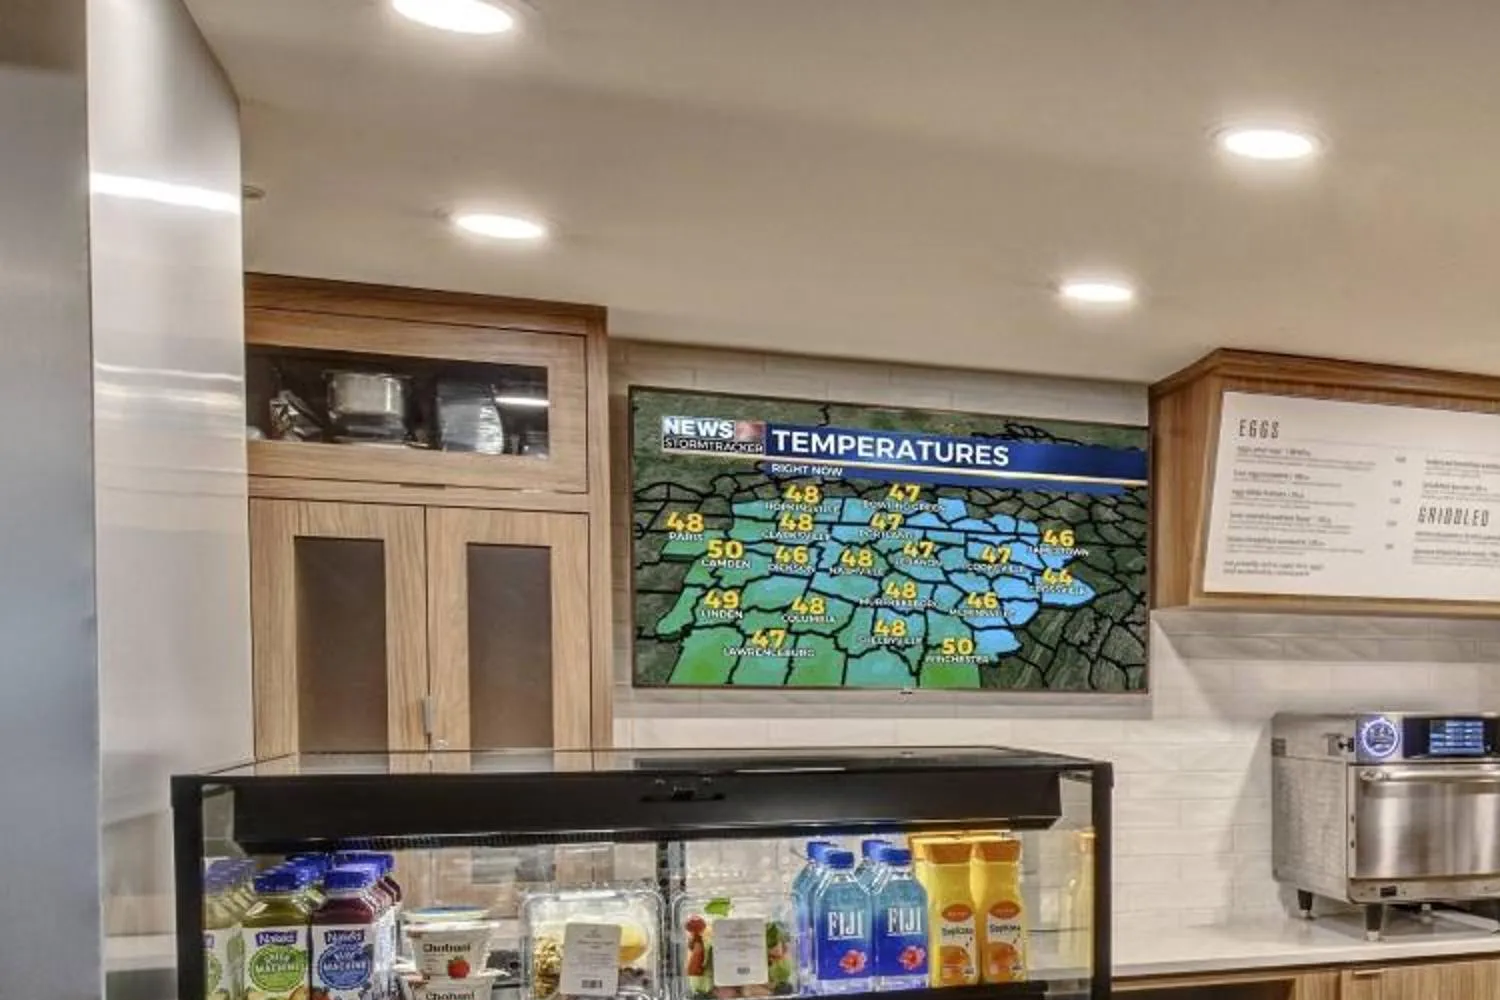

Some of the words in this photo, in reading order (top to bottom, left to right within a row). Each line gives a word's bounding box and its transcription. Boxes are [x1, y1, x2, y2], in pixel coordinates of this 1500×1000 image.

[663, 418, 734, 439] NEWS
[1238, 418, 1280, 440] EGGS
[664, 438, 763, 454] STORMTRACKER
[772, 429, 1009, 466] TEMPERATURES
[772, 463, 809, 475] RIGHT
[812, 466, 844, 477] NOW
[784, 484, 820, 504] 48
[888, 483, 921, 502] 47
[666, 512, 705, 533] 48
[779, 512, 814, 533] 48
[870, 512, 904, 531] 47
[1416, 506, 1490, 527] GRIDDLED
[1042, 529, 1075, 548] 46
[707, 539, 744, 560] 50
[775, 545, 809, 565] 46
[840, 548, 875, 568] 48
[903, 541, 935, 559] 47
[981, 545, 1012, 564] 47
[701, 559, 751, 570] CAMDEN
[703, 588, 741, 610] 49
[885, 581, 918, 600] 48
[966, 591, 999, 610] 46
[701, 609, 743, 620] LINDEN
[791, 596, 826, 616] 48
[874, 618, 907, 638] 48
[751, 629, 786, 648] 47
[941, 637, 974, 657] 50
[828, 909, 864, 938] FIJI
[888, 907, 923, 934] FIJI
[423, 943, 471, 954] Chobani
